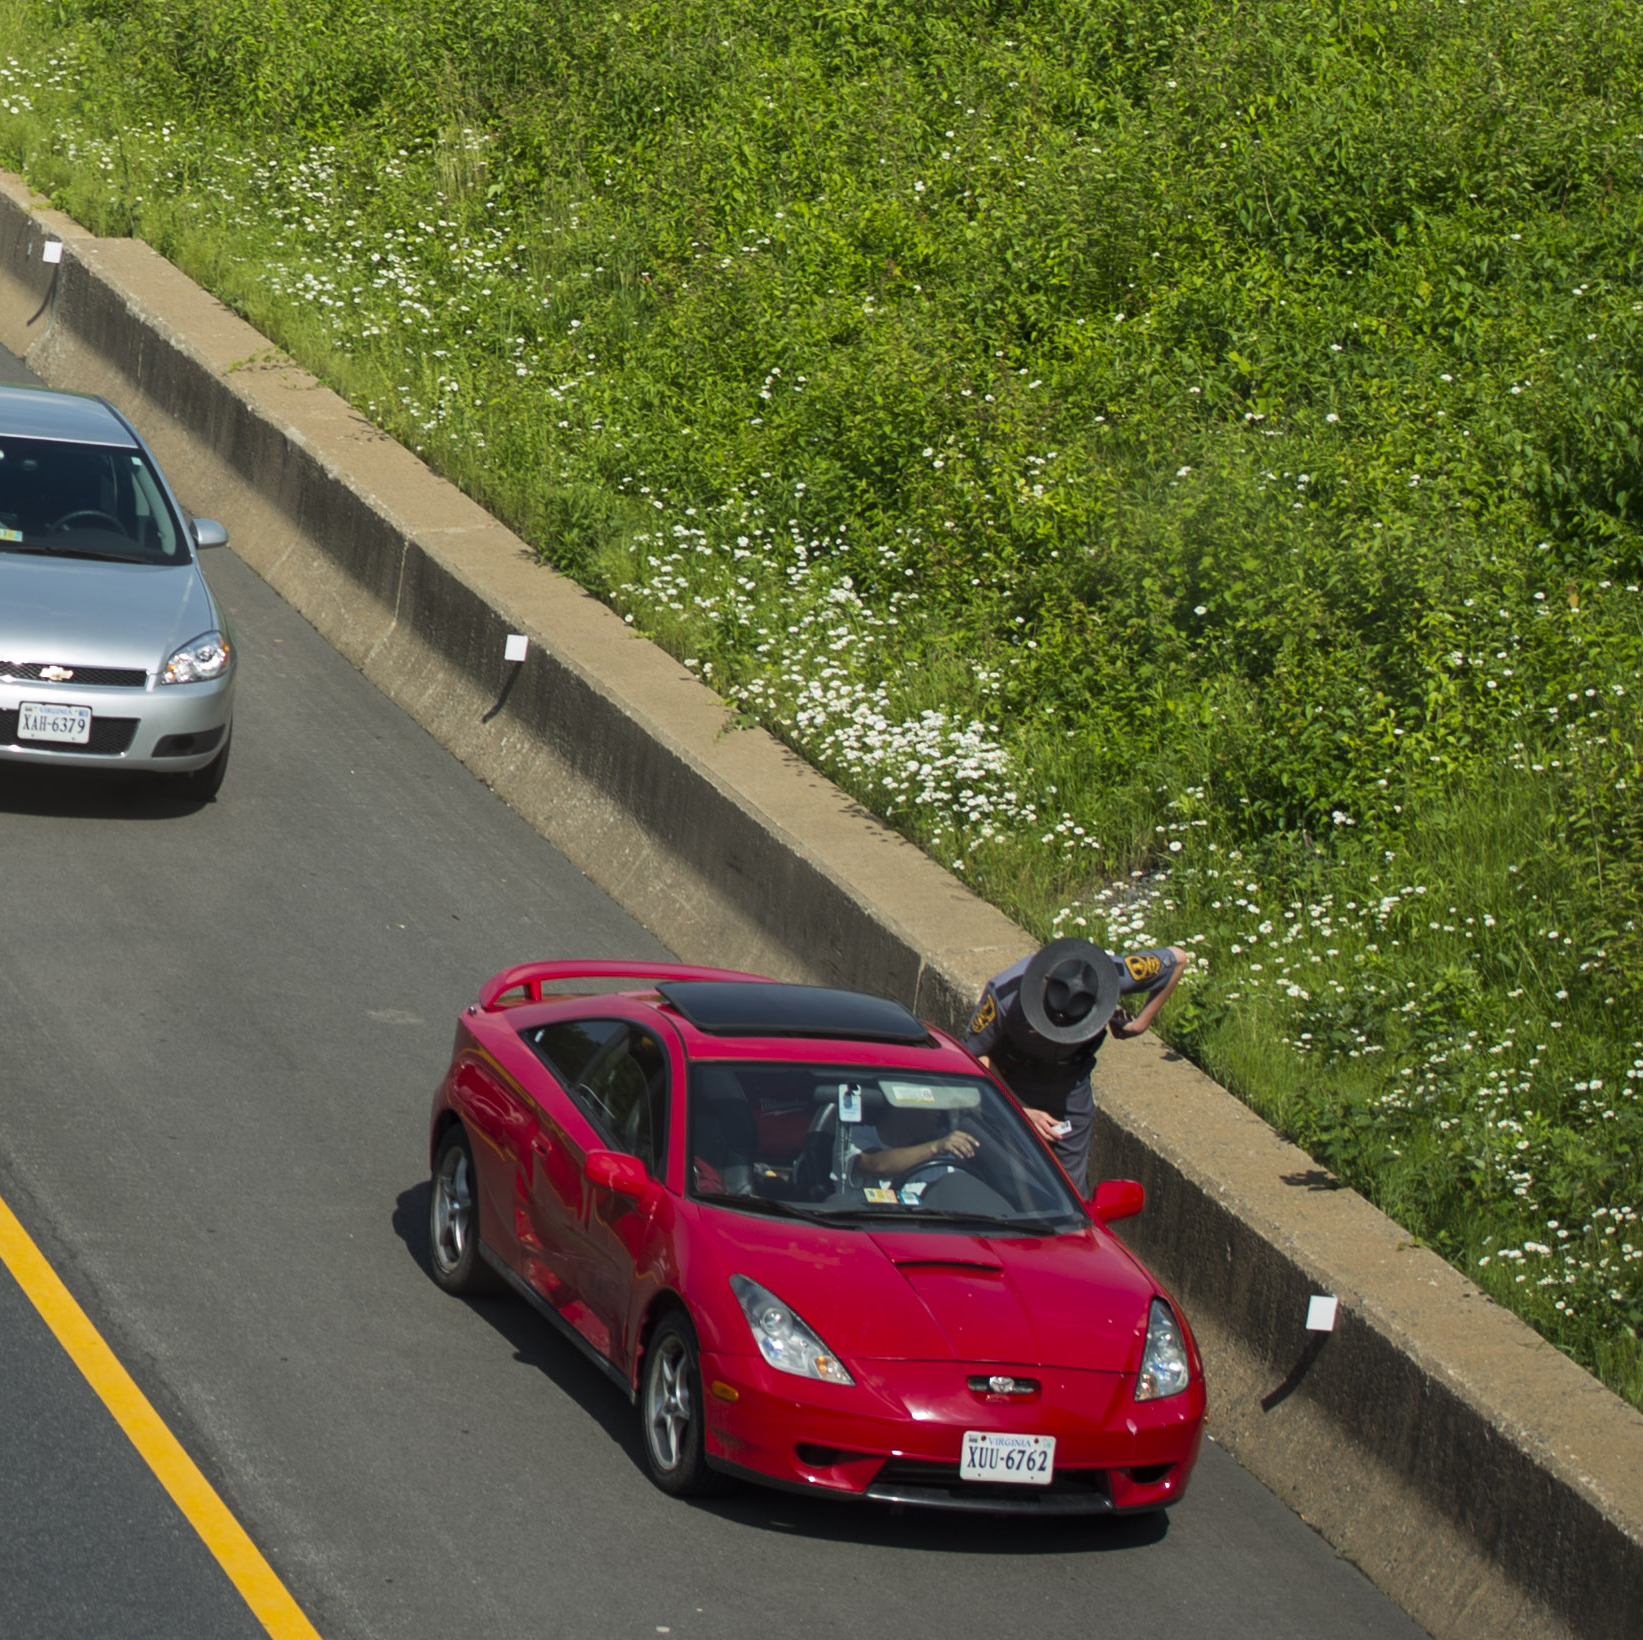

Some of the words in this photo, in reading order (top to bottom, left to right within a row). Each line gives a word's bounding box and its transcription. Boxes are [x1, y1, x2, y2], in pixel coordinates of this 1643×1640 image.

[22, 713, 86, 734] XAH-6379
[988, 1437, 1032, 1448] VIRGINIA
[967, 1445, 1048, 1472] XUU-6762
